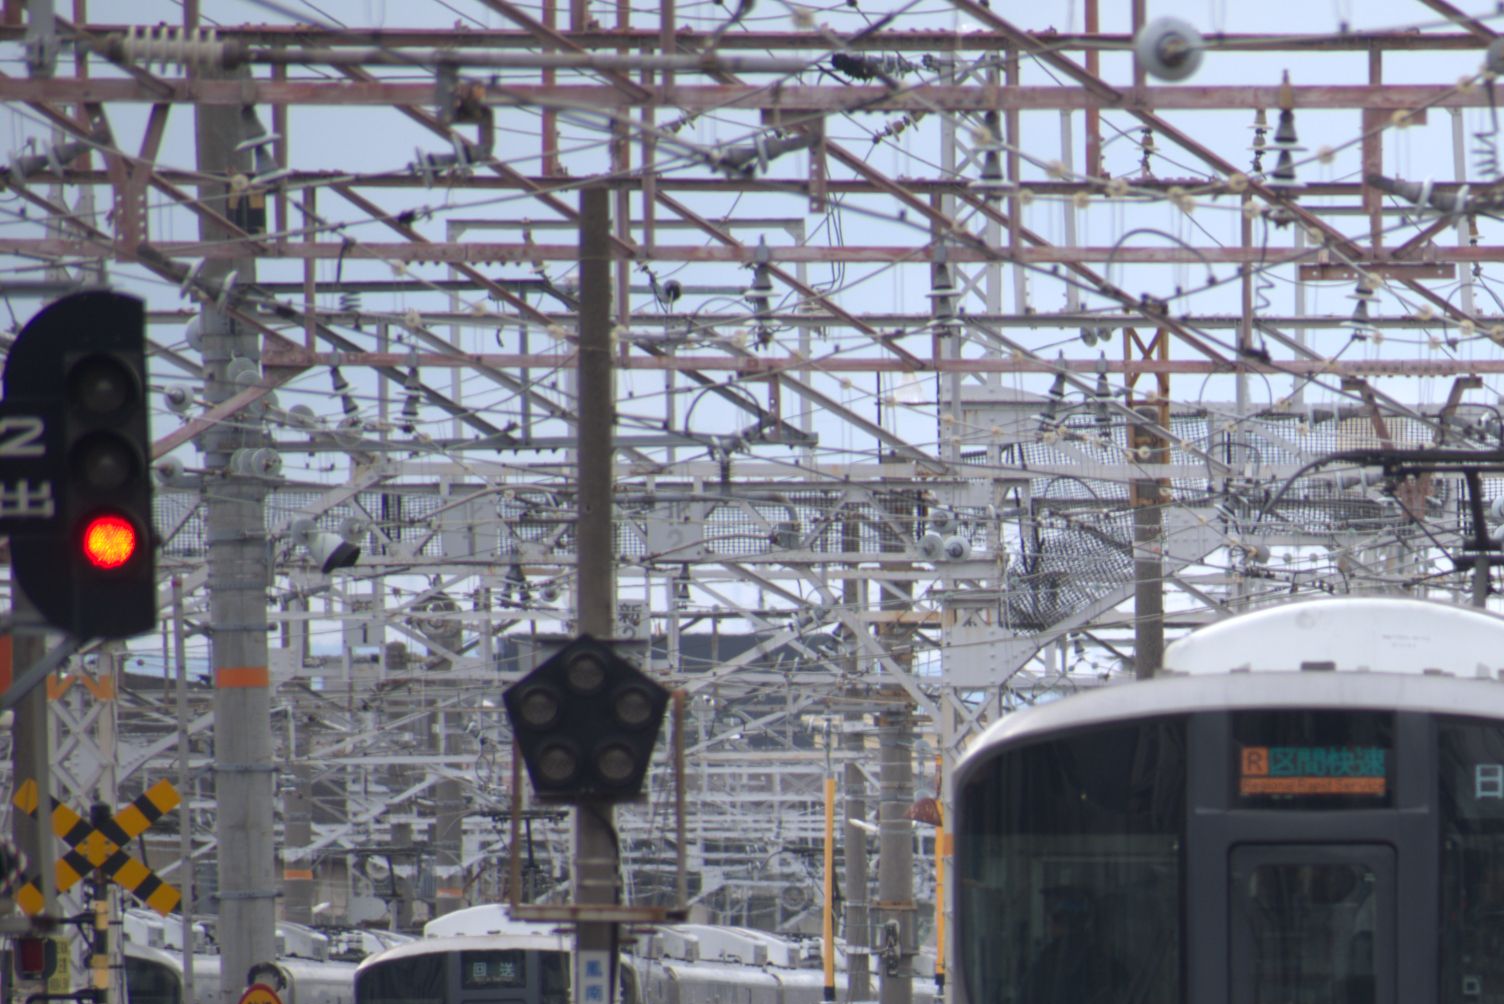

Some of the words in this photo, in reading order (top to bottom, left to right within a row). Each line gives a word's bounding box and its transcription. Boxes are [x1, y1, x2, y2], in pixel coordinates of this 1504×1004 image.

[1248, 752, 1263, 771] R
[1269, 746, 1386, 777] 区間快速
